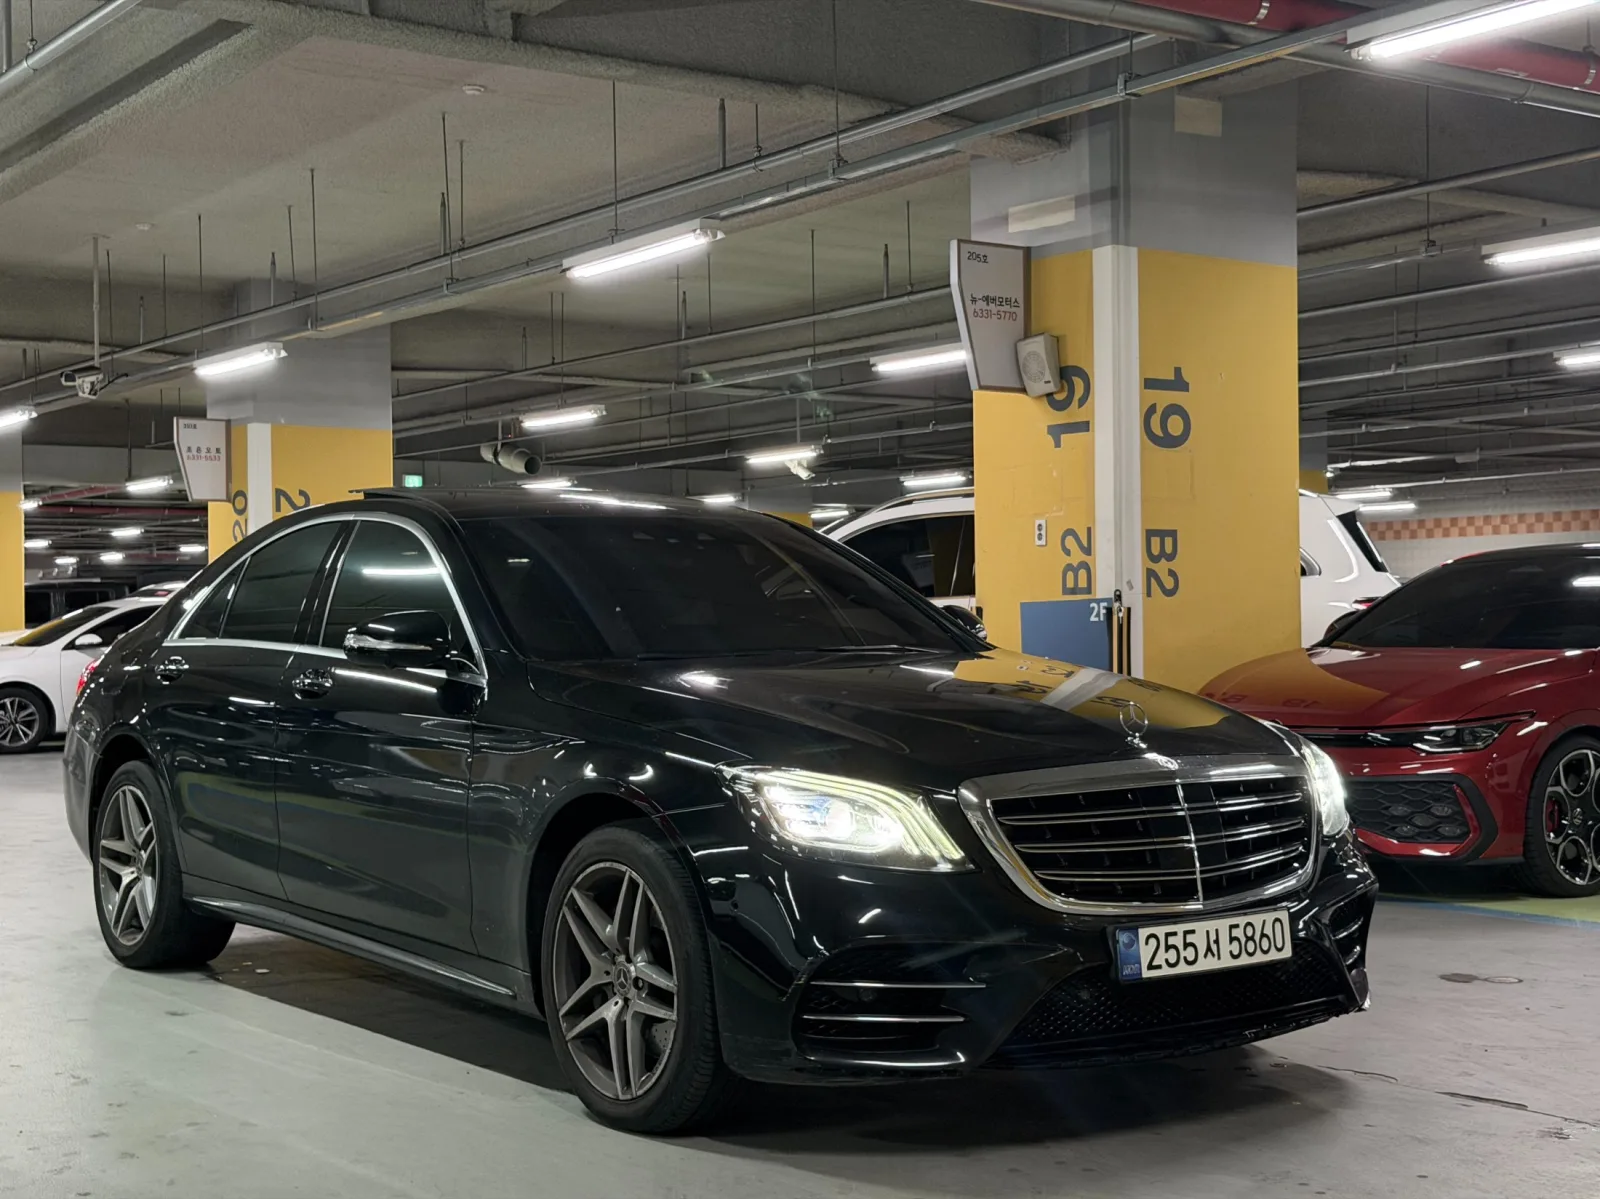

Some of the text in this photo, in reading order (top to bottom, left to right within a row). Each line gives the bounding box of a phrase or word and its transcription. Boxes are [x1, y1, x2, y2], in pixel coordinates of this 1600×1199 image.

[967, 251, 989, 264] 205호
[973, 308, 1018, 321] 6331-5770
[1143, 366, 1191, 449] 19
[1060, 526, 1092, 596] B2
[1145, 528, 1180, 598] B2
[1089, 602, 1108, 621] 2F
